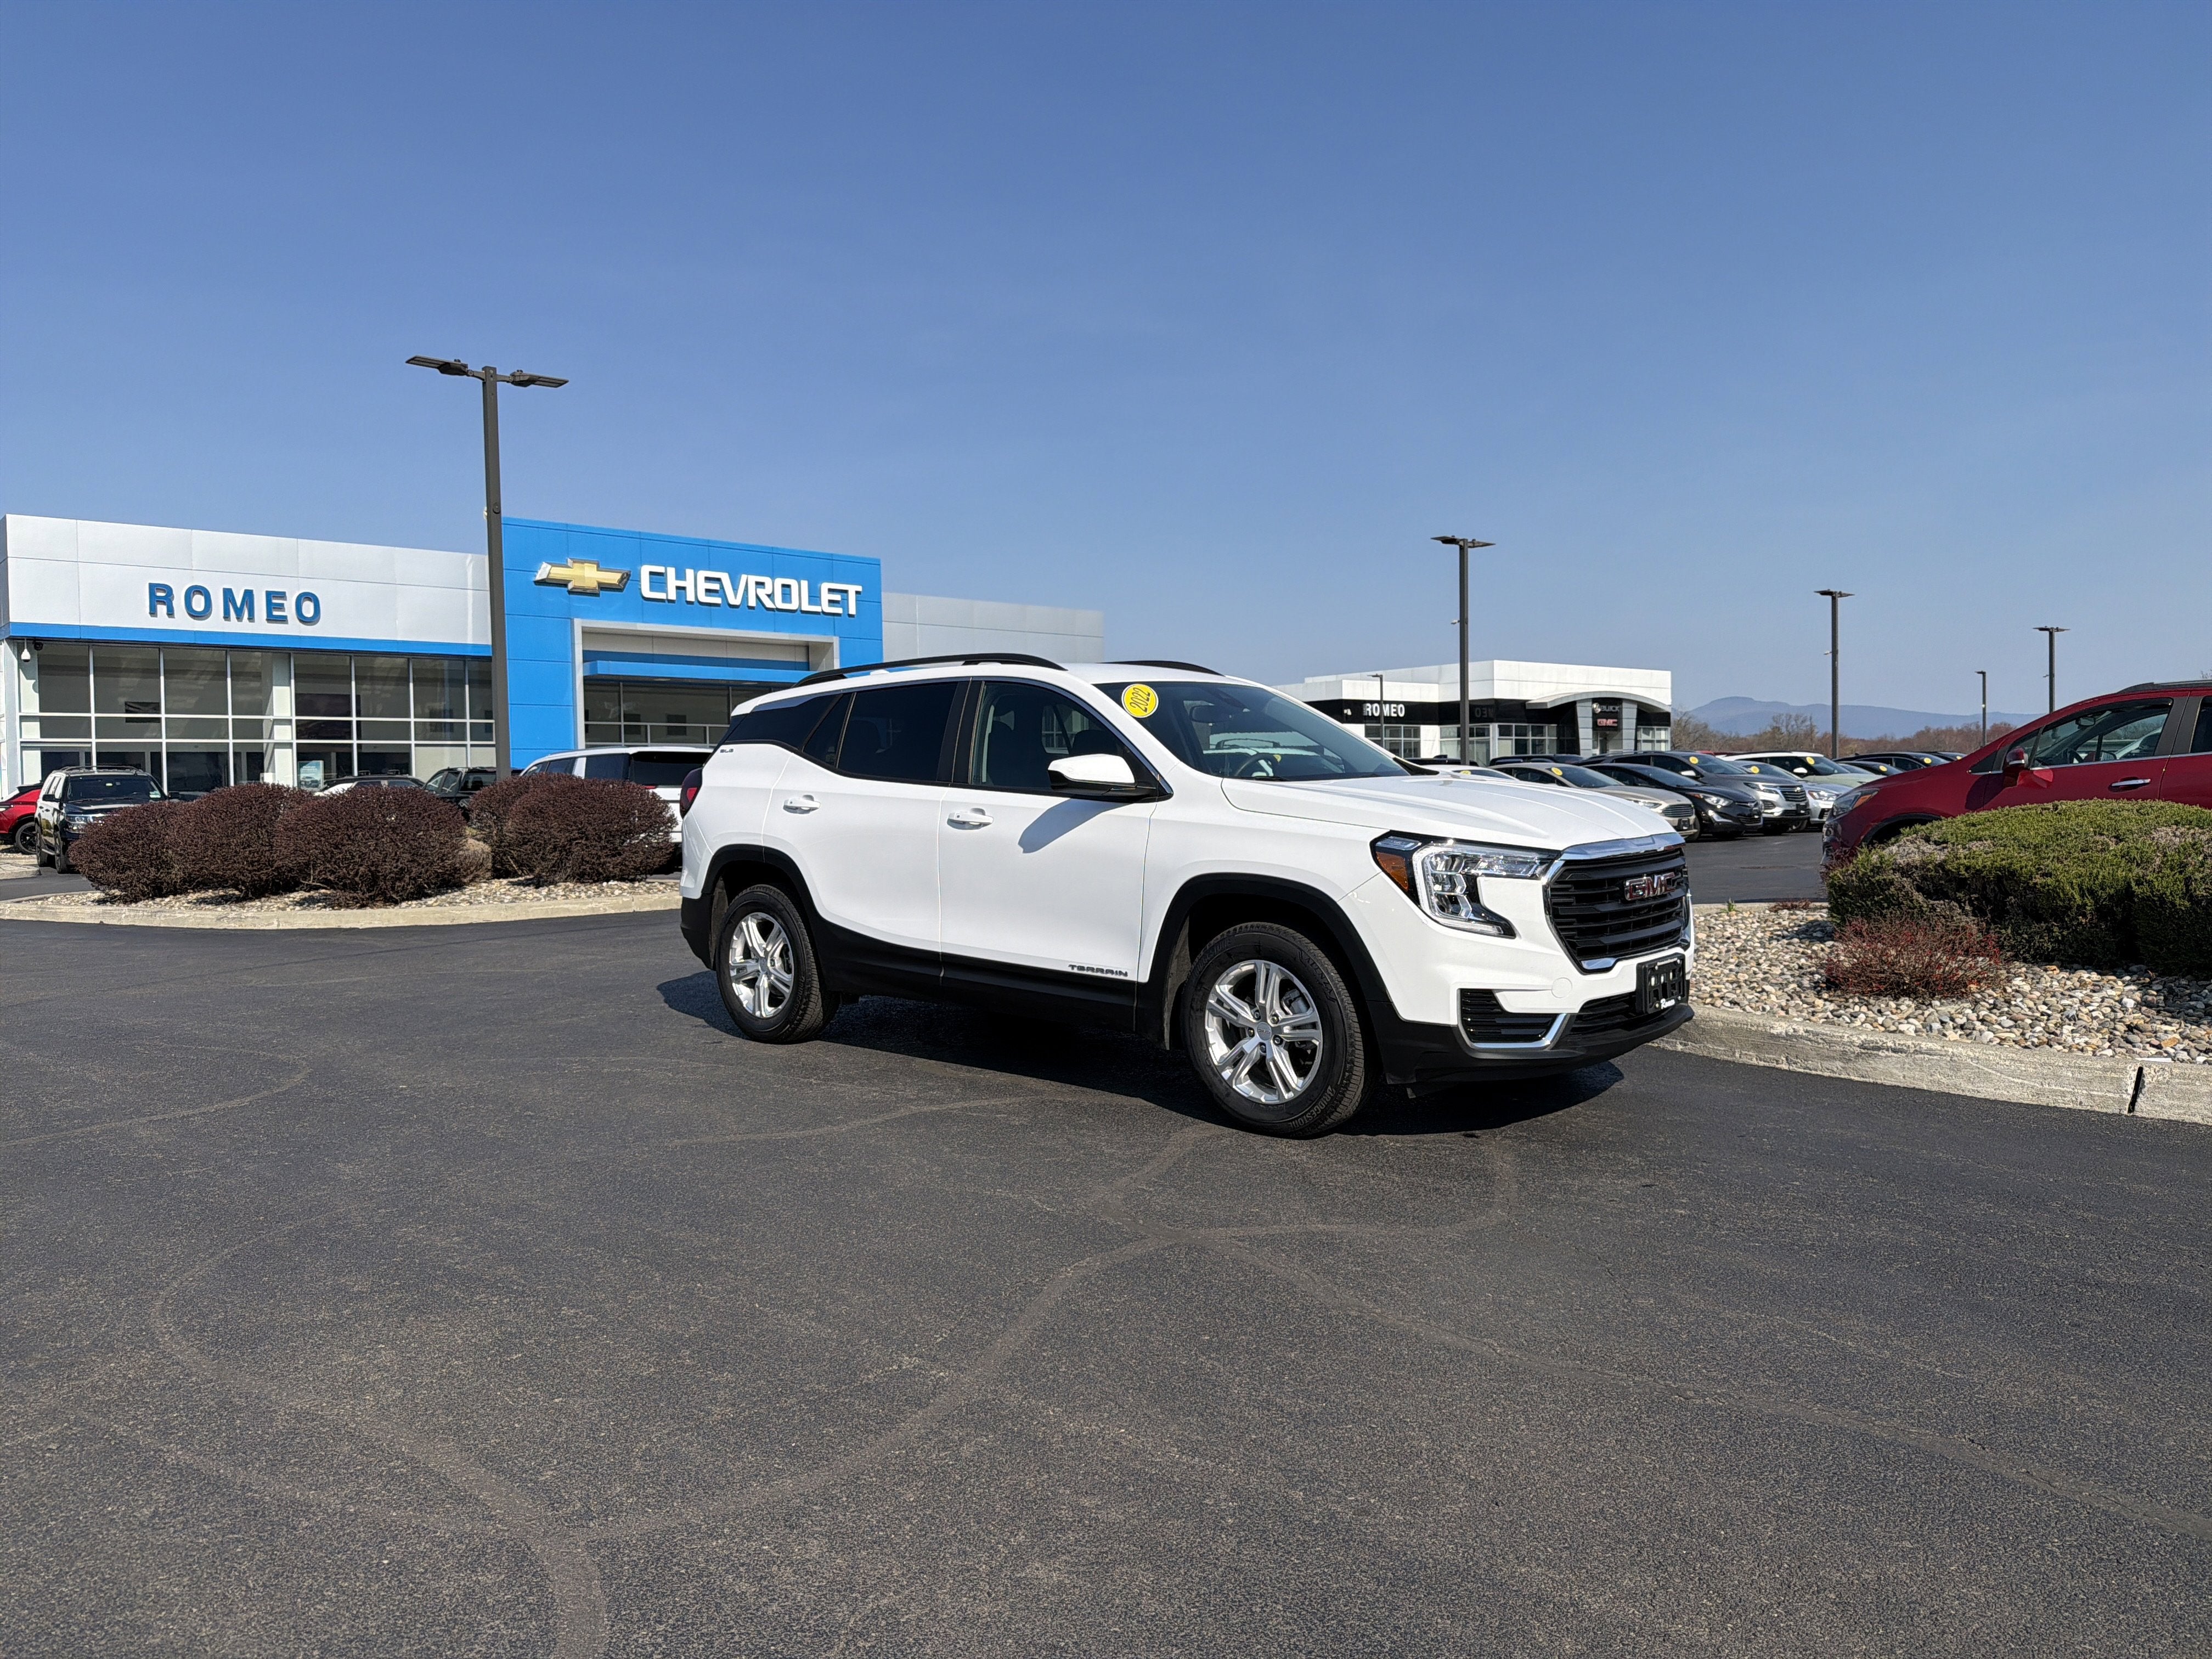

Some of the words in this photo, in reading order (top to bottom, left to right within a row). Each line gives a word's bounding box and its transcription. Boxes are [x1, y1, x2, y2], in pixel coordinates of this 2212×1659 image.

[148, 582, 321, 624] ROMEO
[640, 565, 862, 616] CHEVROLET
[1129, 687, 1150, 713] 2022
[1363, 703, 1405, 717] ROMEO
[1597, 718, 1618, 726] GMC
[1624, 872, 1675, 901] GMC
[1068, 964, 1128, 977] TERRAIN
